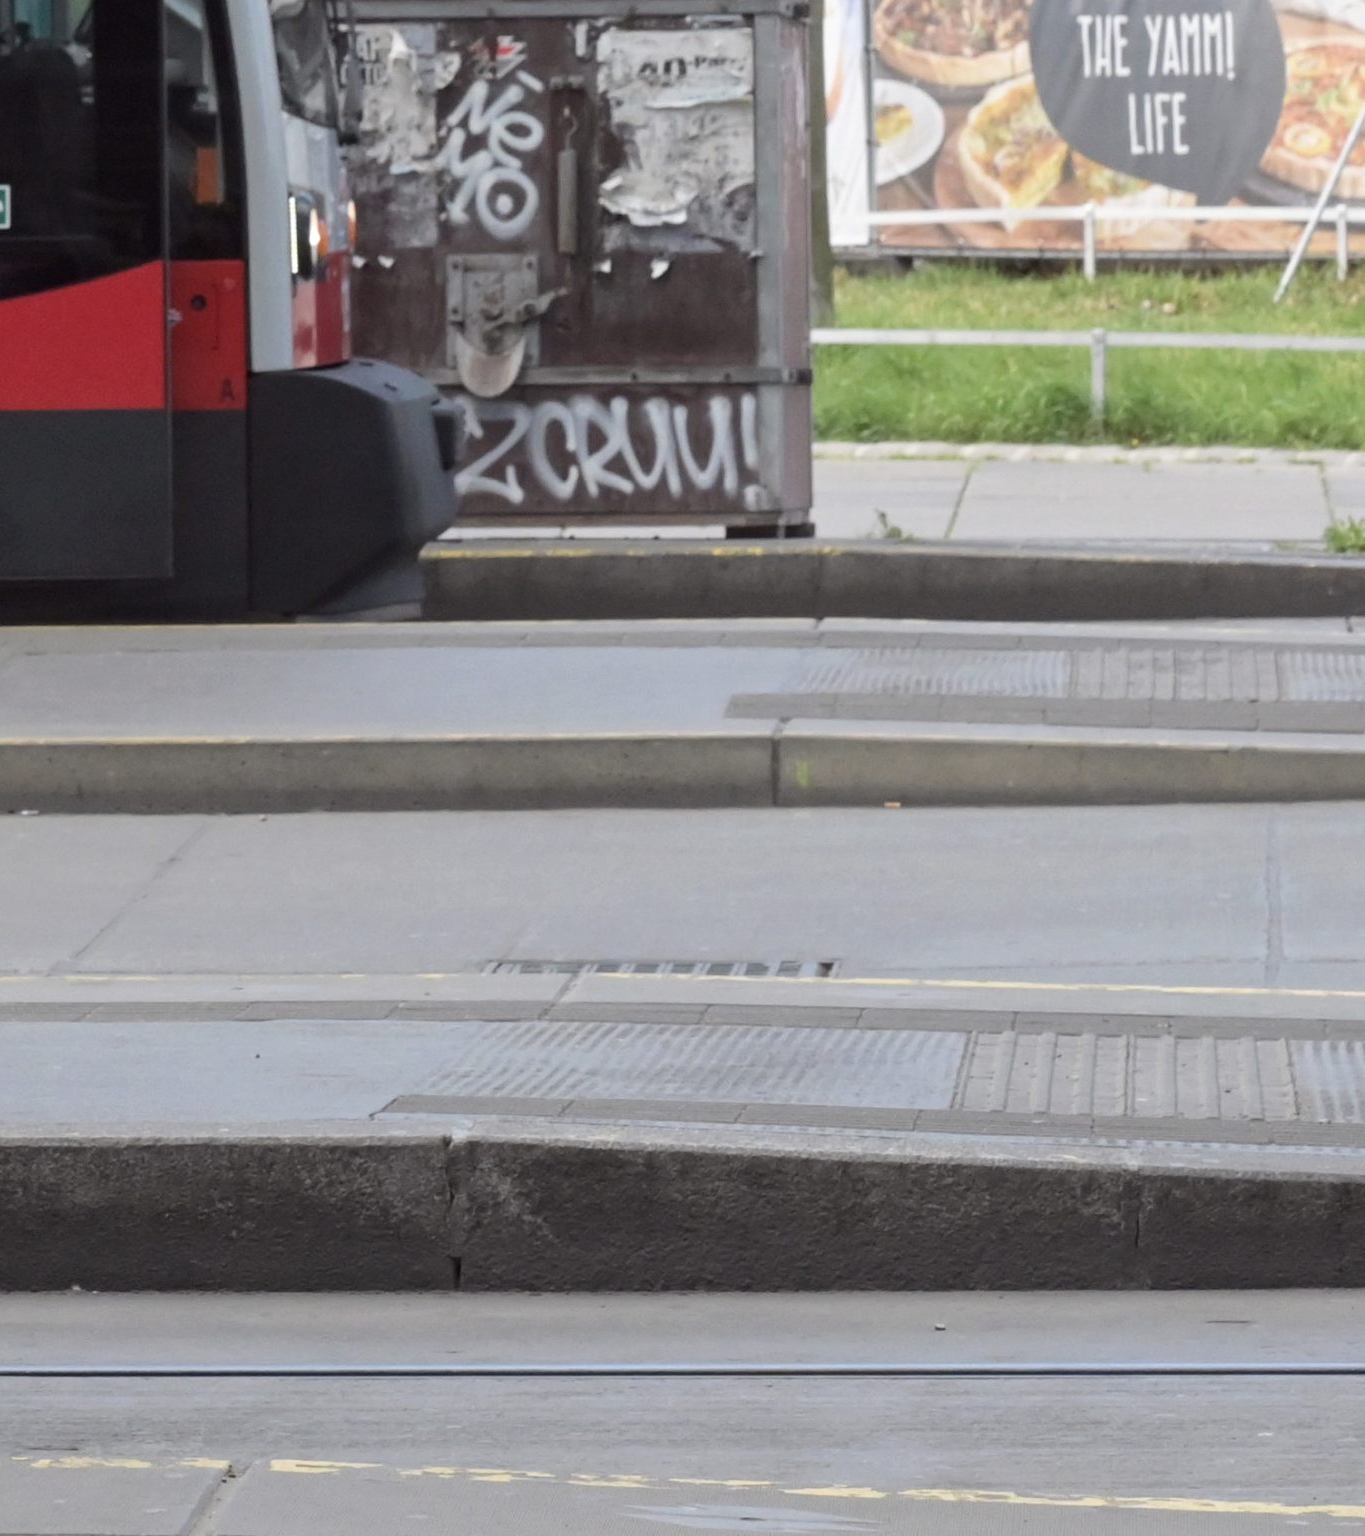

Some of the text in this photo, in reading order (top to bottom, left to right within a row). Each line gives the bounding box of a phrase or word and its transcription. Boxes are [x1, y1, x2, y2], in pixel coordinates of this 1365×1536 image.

[1077, 11, 1236, 80] THE YAMM!
[1128, 92, 1189, 155] LIFE
